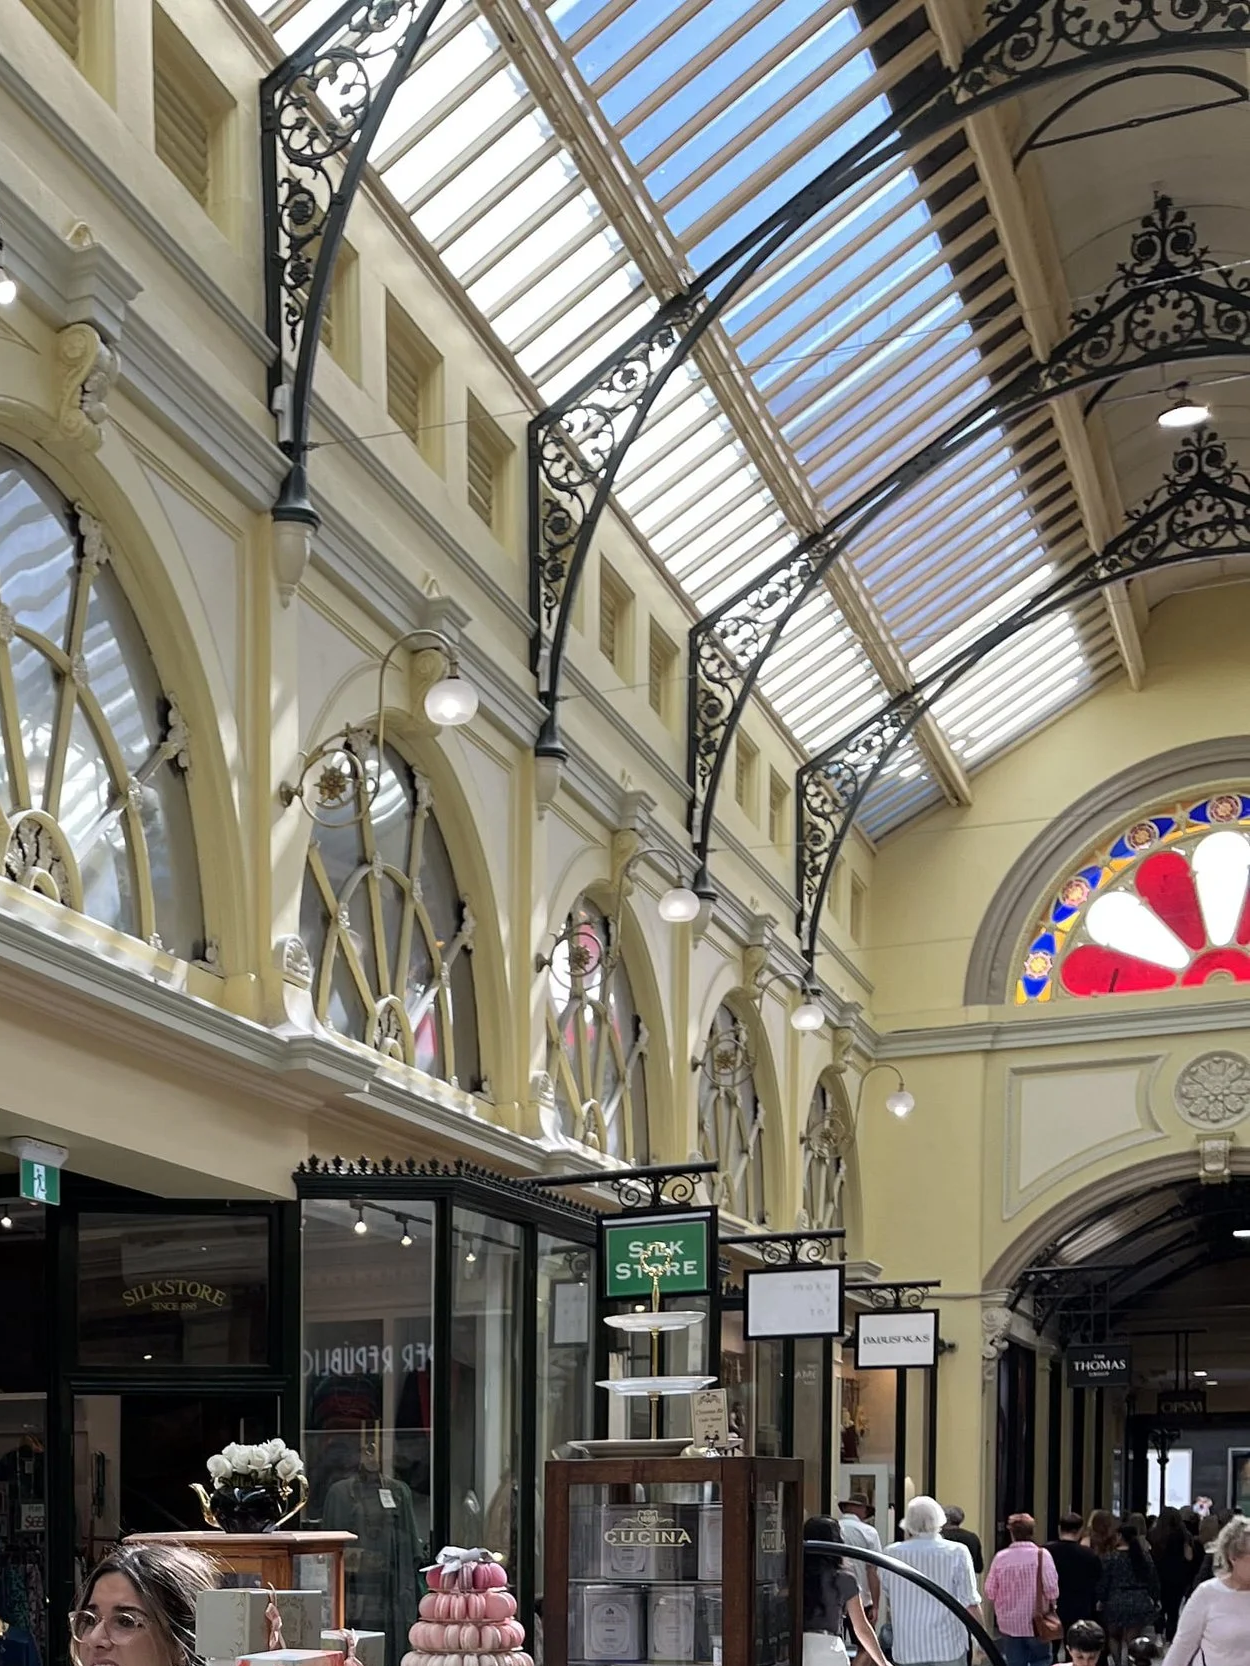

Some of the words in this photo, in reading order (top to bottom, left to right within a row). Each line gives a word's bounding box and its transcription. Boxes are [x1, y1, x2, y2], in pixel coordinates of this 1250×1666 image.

[121, 1278, 227, 1307] SILKSTORE
[151, 1302, 179, 1312] SINCE
[1073, 1359, 1127, 1372] THOMAS
[603, 1529, 693, 1545] CUCINA
